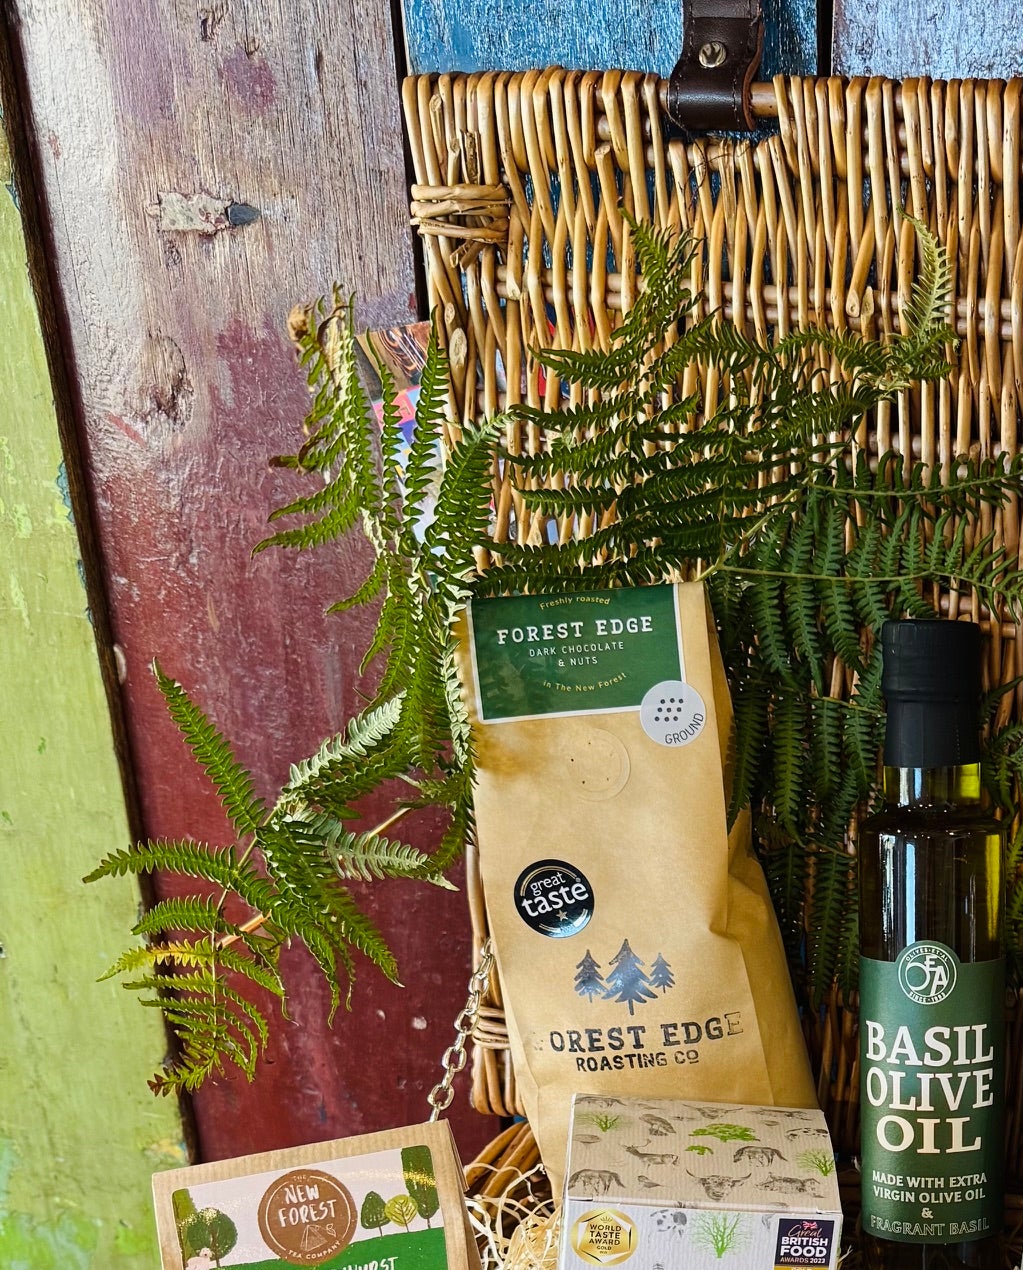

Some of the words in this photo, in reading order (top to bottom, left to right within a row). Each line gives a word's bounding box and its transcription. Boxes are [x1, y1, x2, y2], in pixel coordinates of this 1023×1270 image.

[497, 622, 584, 646] FOREST
[595, 616, 654, 637] EDGE
[529, 645, 557, 657] DARK
[561, 640, 625, 654] CHOCOLATE
[569, 656, 599, 667] NUTS
[555, 682, 572, 693] The
[576, 682, 596, 692] New
[664, 712, 705, 746] GROUND
[530, 870, 566, 897] great
[521, 881, 589, 919] taste
[661, 1011, 744, 1046] EDGE
[865, 1020, 994, 1067] BASIL
[577, 1052, 669, 1073] ROASTING
[866, 1066, 994, 1112] OLIVE
[875, 1116, 982, 1154] OIL
[906, 1176, 945, 1189] WITH
[285, 1183, 319, 1205] NEW
[873, 1185, 916, 1203] VIRGIN
[965, 1188, 986, 1201] OIL
[278, 1200, 337, 1228] FOREST
[870, 1214, 945, 1236] FRAGRANT
[590, 1224, 622, 1232] WORLD
[589, 1238, 620, 1246] AWARD
[780, 1246, 827, 1258] FOOD
[781, 1236, 828, 1247] BRITISH
